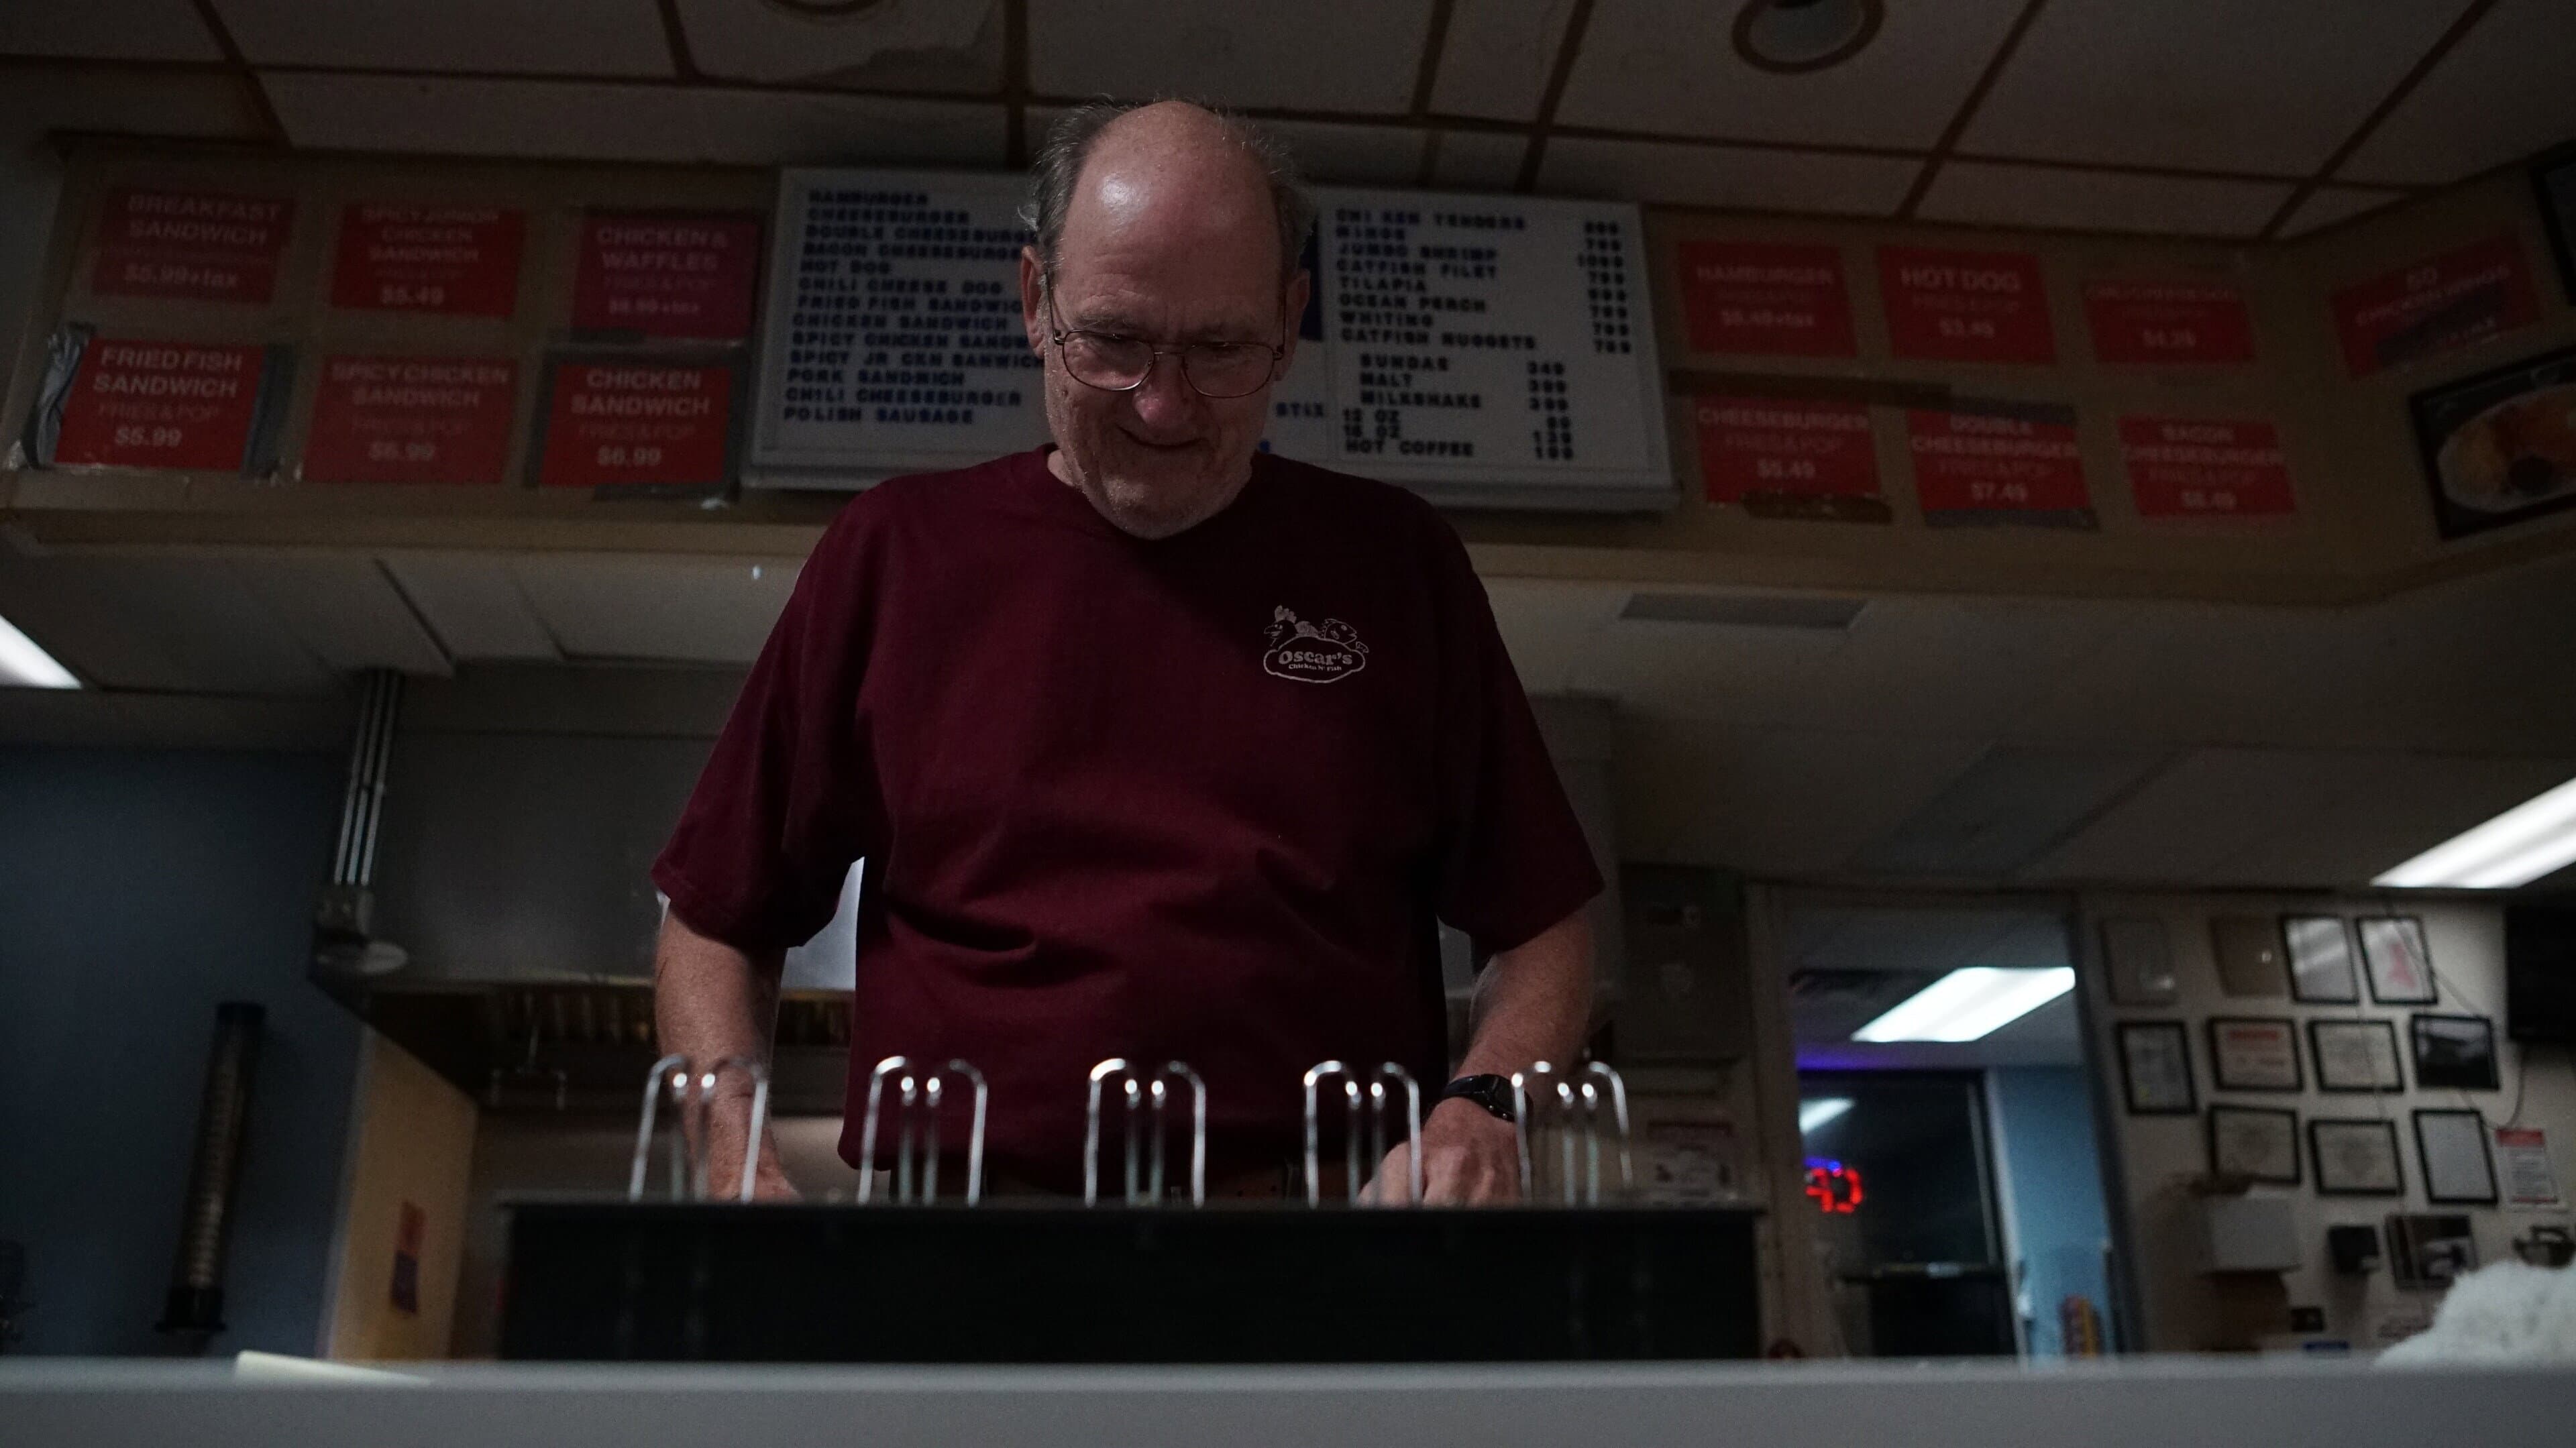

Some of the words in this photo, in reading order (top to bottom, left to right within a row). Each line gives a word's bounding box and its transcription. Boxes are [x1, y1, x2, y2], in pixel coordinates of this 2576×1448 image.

[808, 190, 927, 205] HAMBURGER
[127, 194, 282, 223] BREAKFAST
[808, 209, 969, 223] CHEESEBURGER
[1434, 213, 1525, 229] TENDERS
[129, 219, 266, 245] SANDWICH
[596, 226, 709, 247] CHICKEN
[711, 230, 729, 249] &
[806, 225, 883, 239] DOUBLE
[894, 227, 1037, 243] CHEESEBURGE
[1336, 225, 1405, 241] WINGS
[368, 243, 479, 262] SANDWICH
[602, 250, 719, 270] WAFFLES
[804, 242, 866, 256] BACON
[879, 244, 1020, 260] CHEESEBURGE
[1339, 242, 1407, 258] JUMBO
[1420, 245, 1497, 260] SHRIMP
[802, 260, 838, 273] HOT
[851, 260, 890, 274] DOG
[1337, 259, 1426, 274] CATFISH
[1441, 264, 1497, 278] FILET
[1696, 265, 1835, 286] HAMBURGER
[799, 277, 857, 290] CHILI
[868, 278, 947, 294] CHEESE
[963, 280, 1002, 295] DOG
[1339, 276, 1426, 292] TILAPIA
[1900, 265, 1955, 289] HOT
[1961, 268, 2023, 293] DOG
[798, 296, 860, 309] FRIED
[869, 296, 915, 311] FISH
[929, 298, 1022, 313] SANDWIC
[1339, 293, 1406, 309] OCEAN
[1419, 296, 1485, 313] PERCH
[794, 313, 887, 327] CHICKEN
[900, 315, 1008, 331] SANDWICH
[1340, 311, 1432, 327] WHITING
[793, 330, 855, 345] SPICY
[864, 332, 948, 347] CHICKEN
[959, 334, 1028, 349] SANDW
[1342, 327, 1428, 344] CATFISH
[1442, 332, 1536, 350] NUGGETS
[100, 346, 180, 370] FRIED
[183, 349, 243, 372] FISH
[790, 349, 850, 364] SPICY
[865, 352, 888, 366] JR
[902, 353, 943, 367] CKN
[1360, 353, 1448, 371] SUNDAE
[332, 361, 401, 382] SPICY
[404, 363, 509, 386] CHICKEN
[586, 368, 702, 391] CHICKEN
[788, 368, 843, 383] PORK
[858, 370, 965, 386] SANDWICH
[1360, 372, 1411, 388] MALT
[93, 372, 237, 398] SANDWICH
[353, 386, 480, 408] SANDWICH
[570, 394, 710, 416] SANDWICH
[786, 386, 845, 402] CHILI
[856, 388, 1021, 406] CHEESEBURGER
[1360, 390, 1481, 409] MILKSHAKE
[784, 406, 861, 422] POLISH
[875, 407, 973, 424] SAUSAGE
[1698, 406, 1870, 433] CHEESEBURGER
[1949, 413, 2035, 436] DOUBLE
[115, 425, 183, 447] $5.99
[2161, 424, 2235, 443] BACON
[1346, 439, 1385, 454] HOT
[1399, 441, 1473, 457] COFFEE
[1911, 435, 2080, 459] CHEESEBURGER
[1278, 651, 1353, 666] Oscar's
